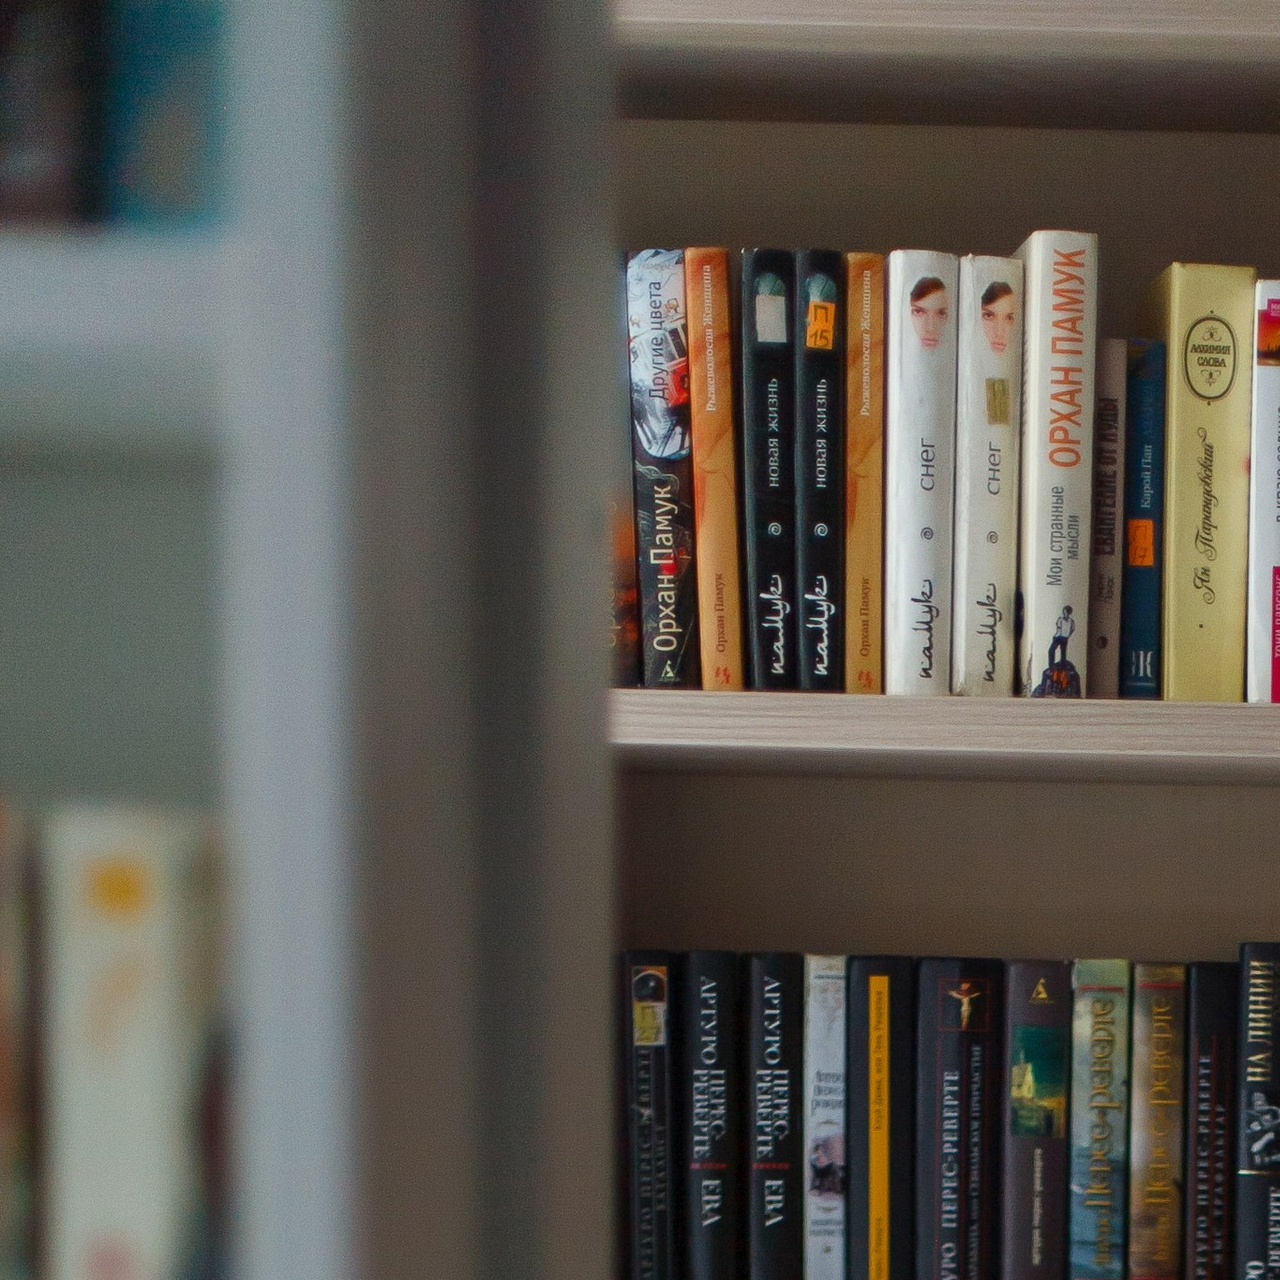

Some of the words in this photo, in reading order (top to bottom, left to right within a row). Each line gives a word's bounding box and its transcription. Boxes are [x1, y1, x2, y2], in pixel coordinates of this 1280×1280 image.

[647, 281, 665, 333] цвета
[1051, 249, 1086, 355] ПАМУК
[649, 337, 669, 401] Другие
[766, 378, 780, 434] жизнь
[814, 379, 828, 434] жизнь
[1049, 366, 1083, 468] ОРХАН
[767, 438, 780, 488] новая
[814, 438, 828, 488] новая
[919, 438, 936, 491] снег
[986, 442, 1001, 495] снег
[650, 485, 681, 565] Памук
[1048, 485, 1066, 552] странные
[1064, 515, 1080, 560] мысли
[1046, 554, 1062, 586] Мои
[652, 574, 683, 651] Орхан
[700, 975, 718, 1065] АРТУРО
[763, 975, 781, 1065] АРТУРО
[1247, 960, 1274, 1046] ЛИНИИ
[702, 1179, 721, 1227] ЕВА
[765, 1179, 784, 1227] ЕВА
